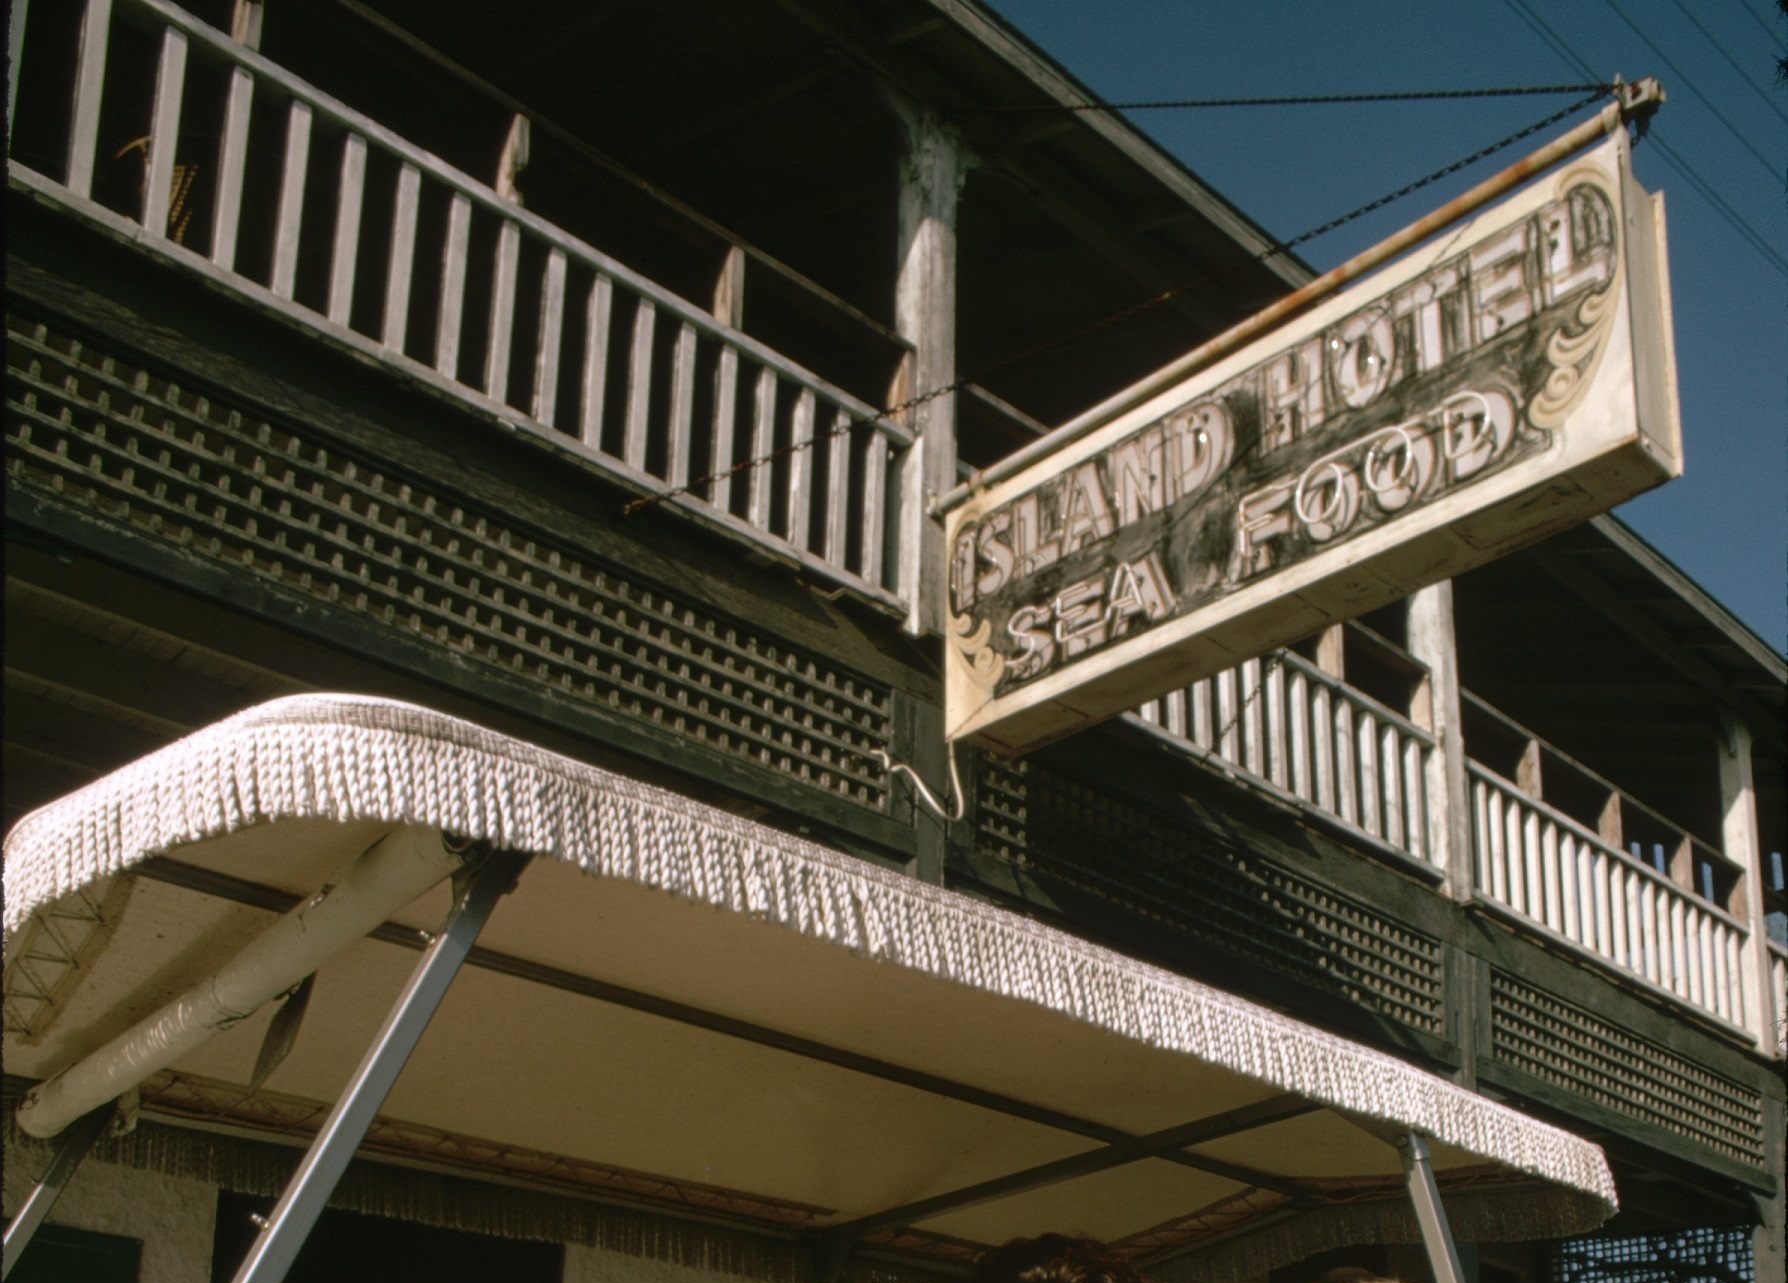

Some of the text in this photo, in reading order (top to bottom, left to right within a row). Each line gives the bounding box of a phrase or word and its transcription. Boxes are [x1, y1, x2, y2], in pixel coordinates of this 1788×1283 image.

[952, 198, 1616, 612] ISLAND HOTEL
[1004, 390, 1516, 680] SEA FOOD
